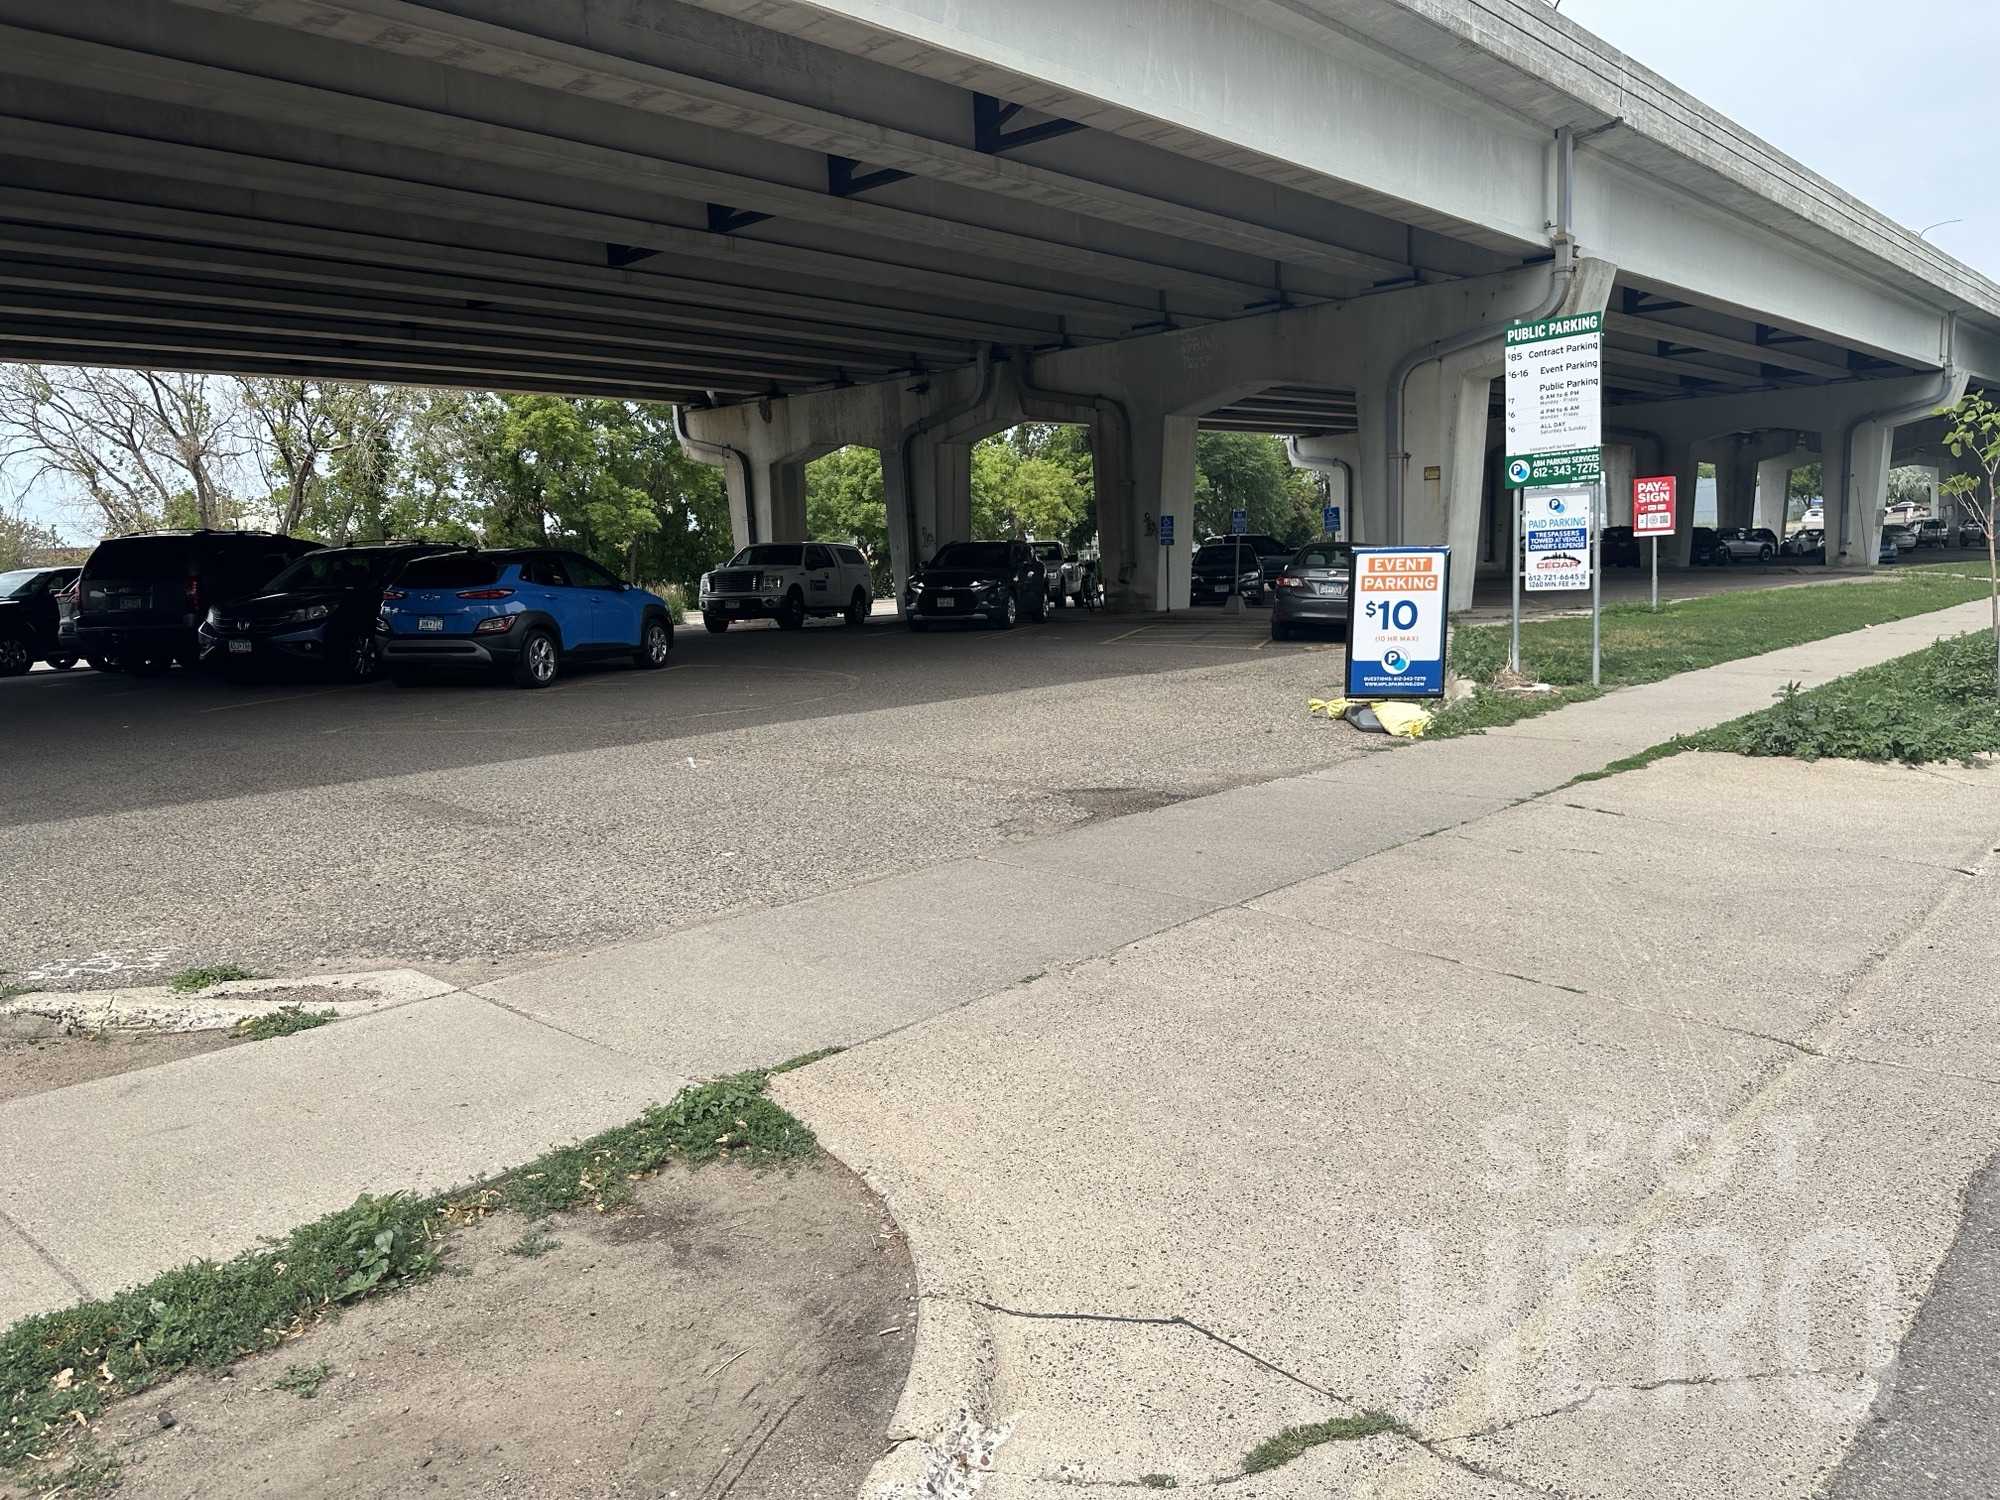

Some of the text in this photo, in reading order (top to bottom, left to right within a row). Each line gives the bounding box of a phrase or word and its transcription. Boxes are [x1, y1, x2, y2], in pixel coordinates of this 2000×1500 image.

[1507, 315, 1598, 342] PUBLIC PARKING
[1528, 346, 1564, 359] Contract
[1566, 341, 1598, 353] Parking
[1540, 364, 1564, 375] Event
[1566, 360, 1598, 371] Parking
[1539, 377, 1599, 393] Public Parking
[1546, 456, 1571, 466] PARKING
[1571, 454, 1600, 464] SERVICES
[1533, 462, 1600, 478] 612-343-7275
[1637, 481, 1662, 493] PAY
[1637, 491, 1670, 504] SIGN
[1528, 517, 1586, 529] PAID PARKING
[1535, 530, 1580, 538] TRESPASSERS
[1374, 558, 1427, 571] EVENT
[1536, 561, 1578, 569] CEDAR
[1364, 576, 1436, 590] PARKING
[1528, 573, 1580, 581] 612-721-6645
[1365, 600, 1418, 630] $10
